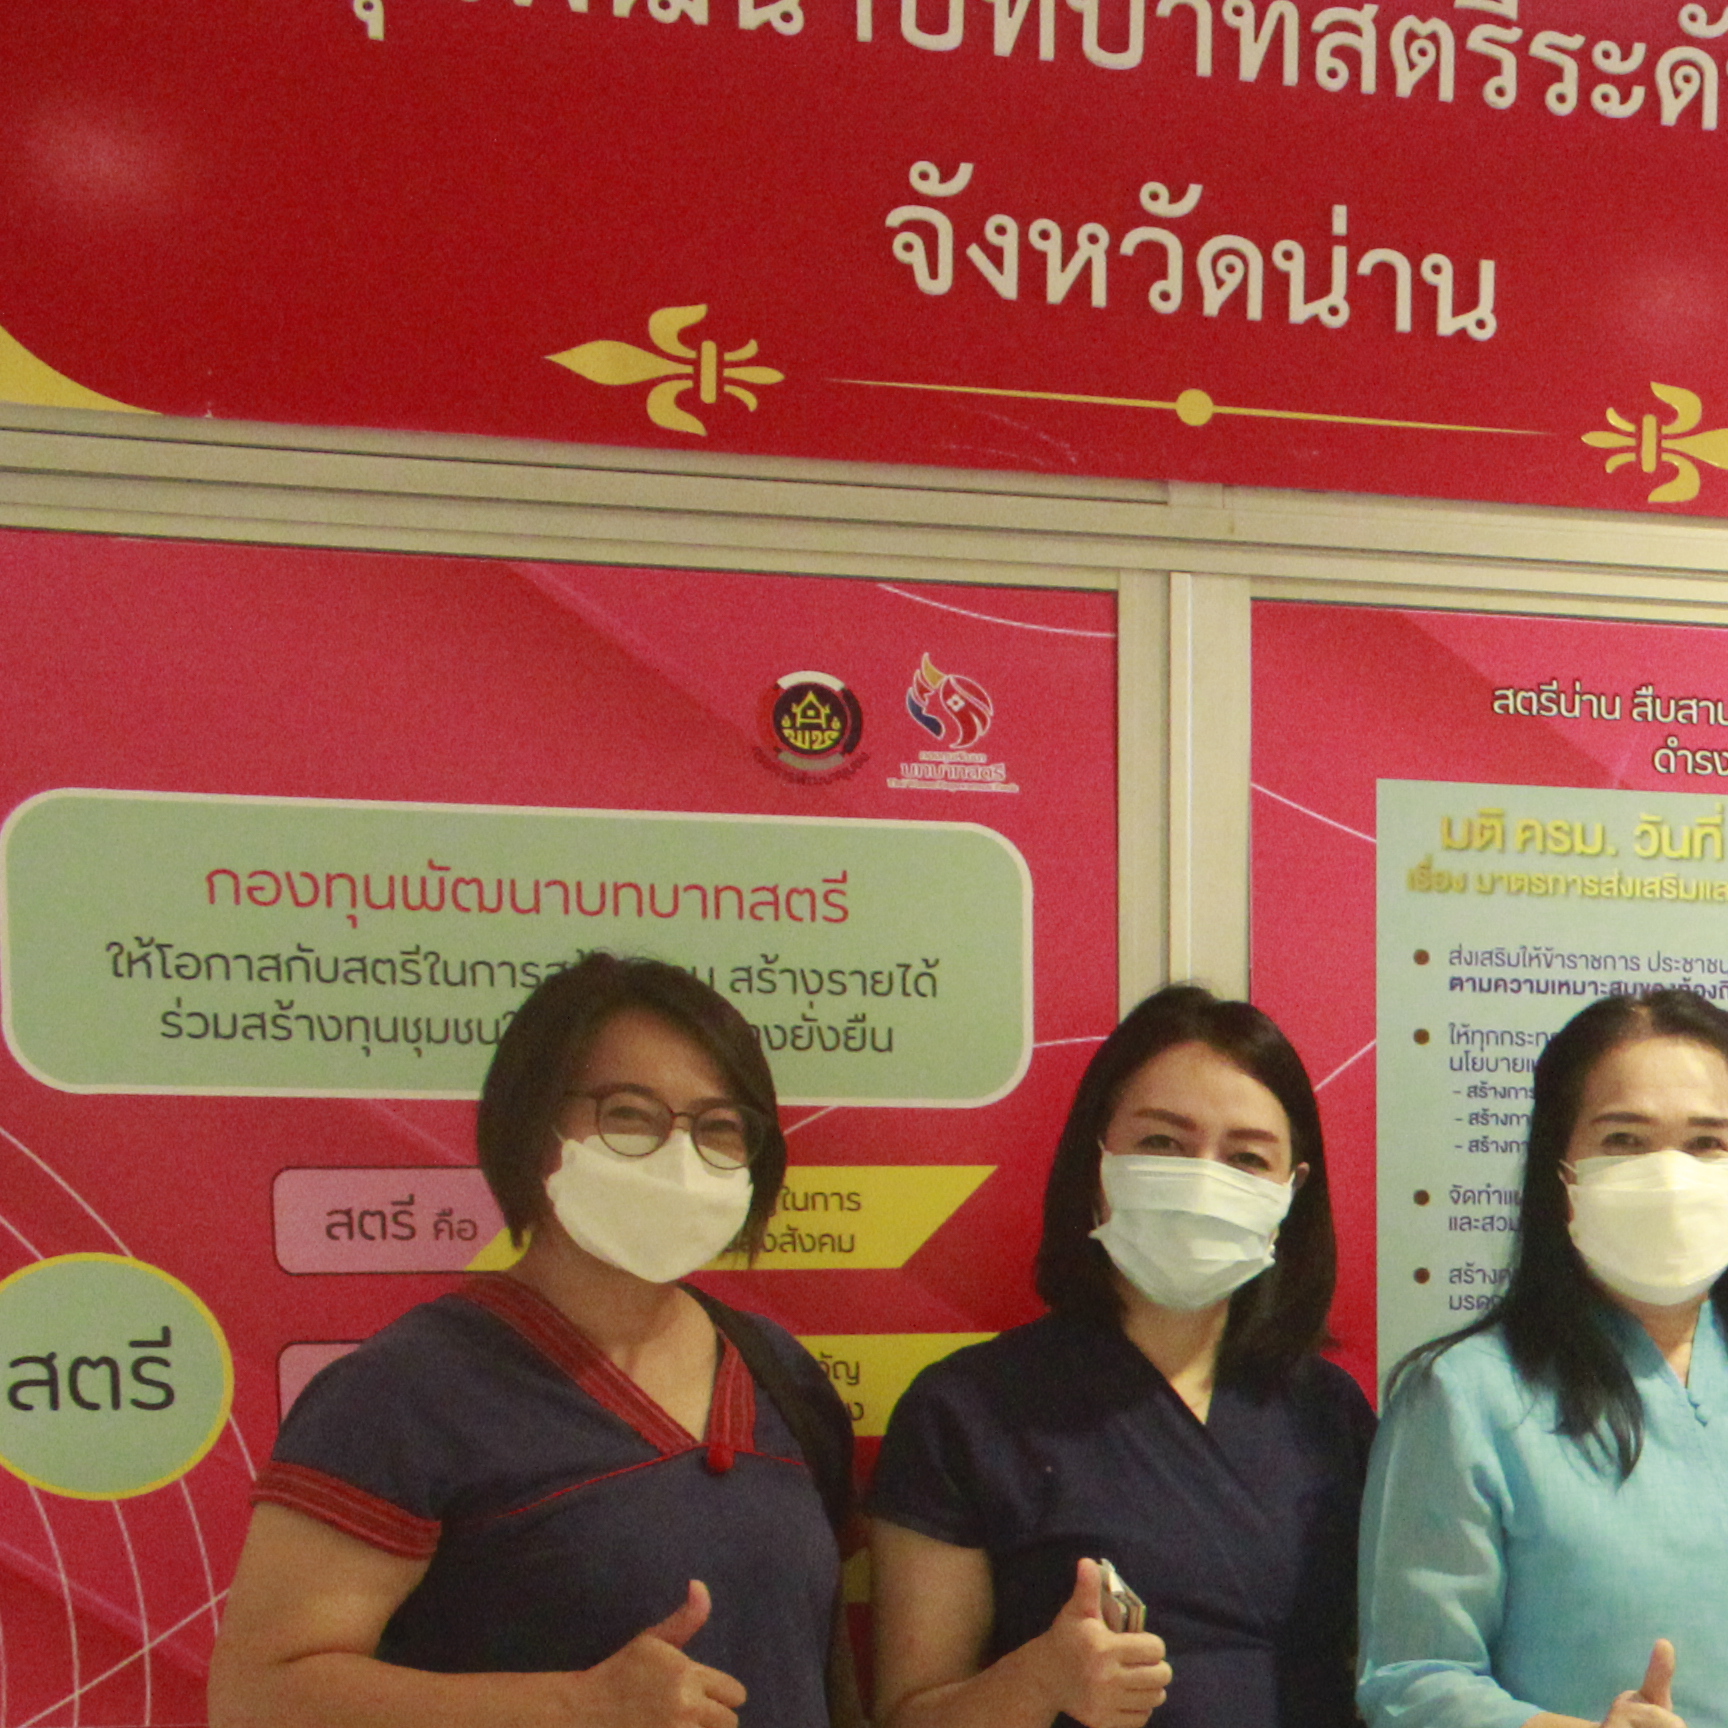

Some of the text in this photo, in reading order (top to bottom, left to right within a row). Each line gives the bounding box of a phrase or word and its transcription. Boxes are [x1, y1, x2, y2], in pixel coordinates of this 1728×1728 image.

[885, 160, 1499, 340] จังหวัดน่าน
[1492, 679, 1621, 721] สตรีน่าน
[1439, 806, 1506, 853] มติ
[1516, 815, 1617, 857] ครม.
[1633, 803, 1724, 862] วันที่
[203, 858, 852, 936] กองทุนพัฒนาบทบาทสตรี
[729, 952, 940, 998] สร้างรายได้
[1447, 946, 1641, 973] ส่งเสริมให้ข้าราชการ
[747, 1000, 895, 1053] างยั่งยืน
[1468, 1107, 1532, 1127] สร้างกา
[1468, 1134, 1530, 1154] สร้างกา
[324, 1193, 479, 1244] สตรี คือ
[779, 1185, 862, 1212] ในการ
[762, 1223, 856, 1254] งสังคม
[6, 1324, 177, 1413] สตรี
